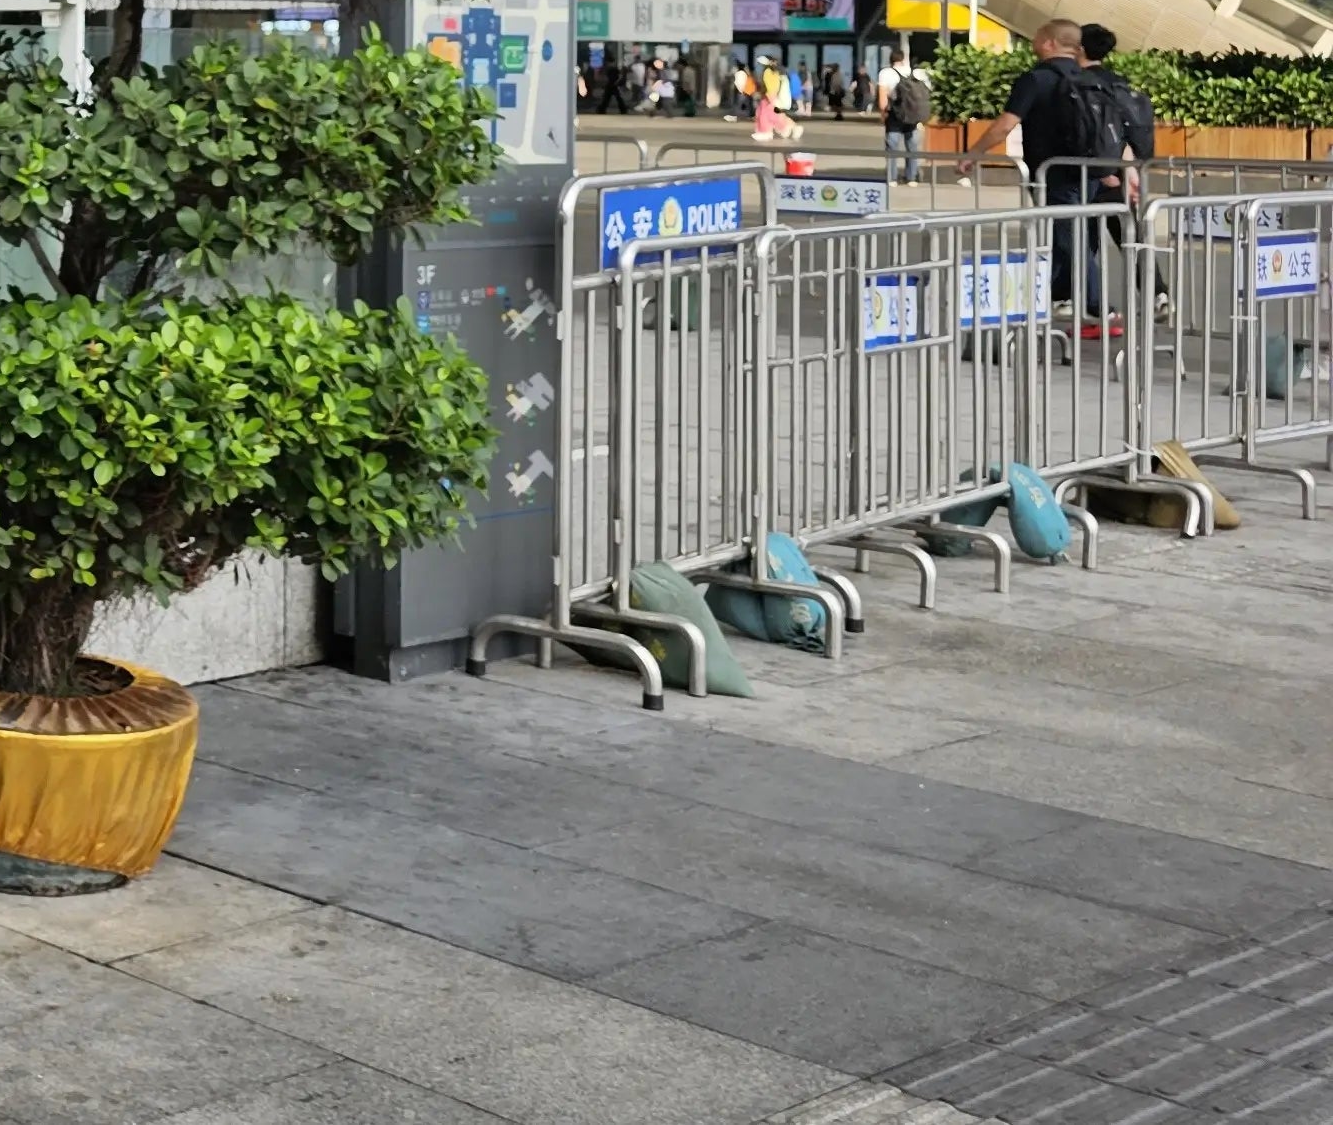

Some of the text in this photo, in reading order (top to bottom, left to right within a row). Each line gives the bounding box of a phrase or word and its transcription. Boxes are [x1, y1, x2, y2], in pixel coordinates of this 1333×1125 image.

[843, 187, 881, 205] 公安
[604, 200, 738, 250] 公安 POLICE
[416, 265, 436, 286] 3F
[1288, 250, 1311, 277] 公安
